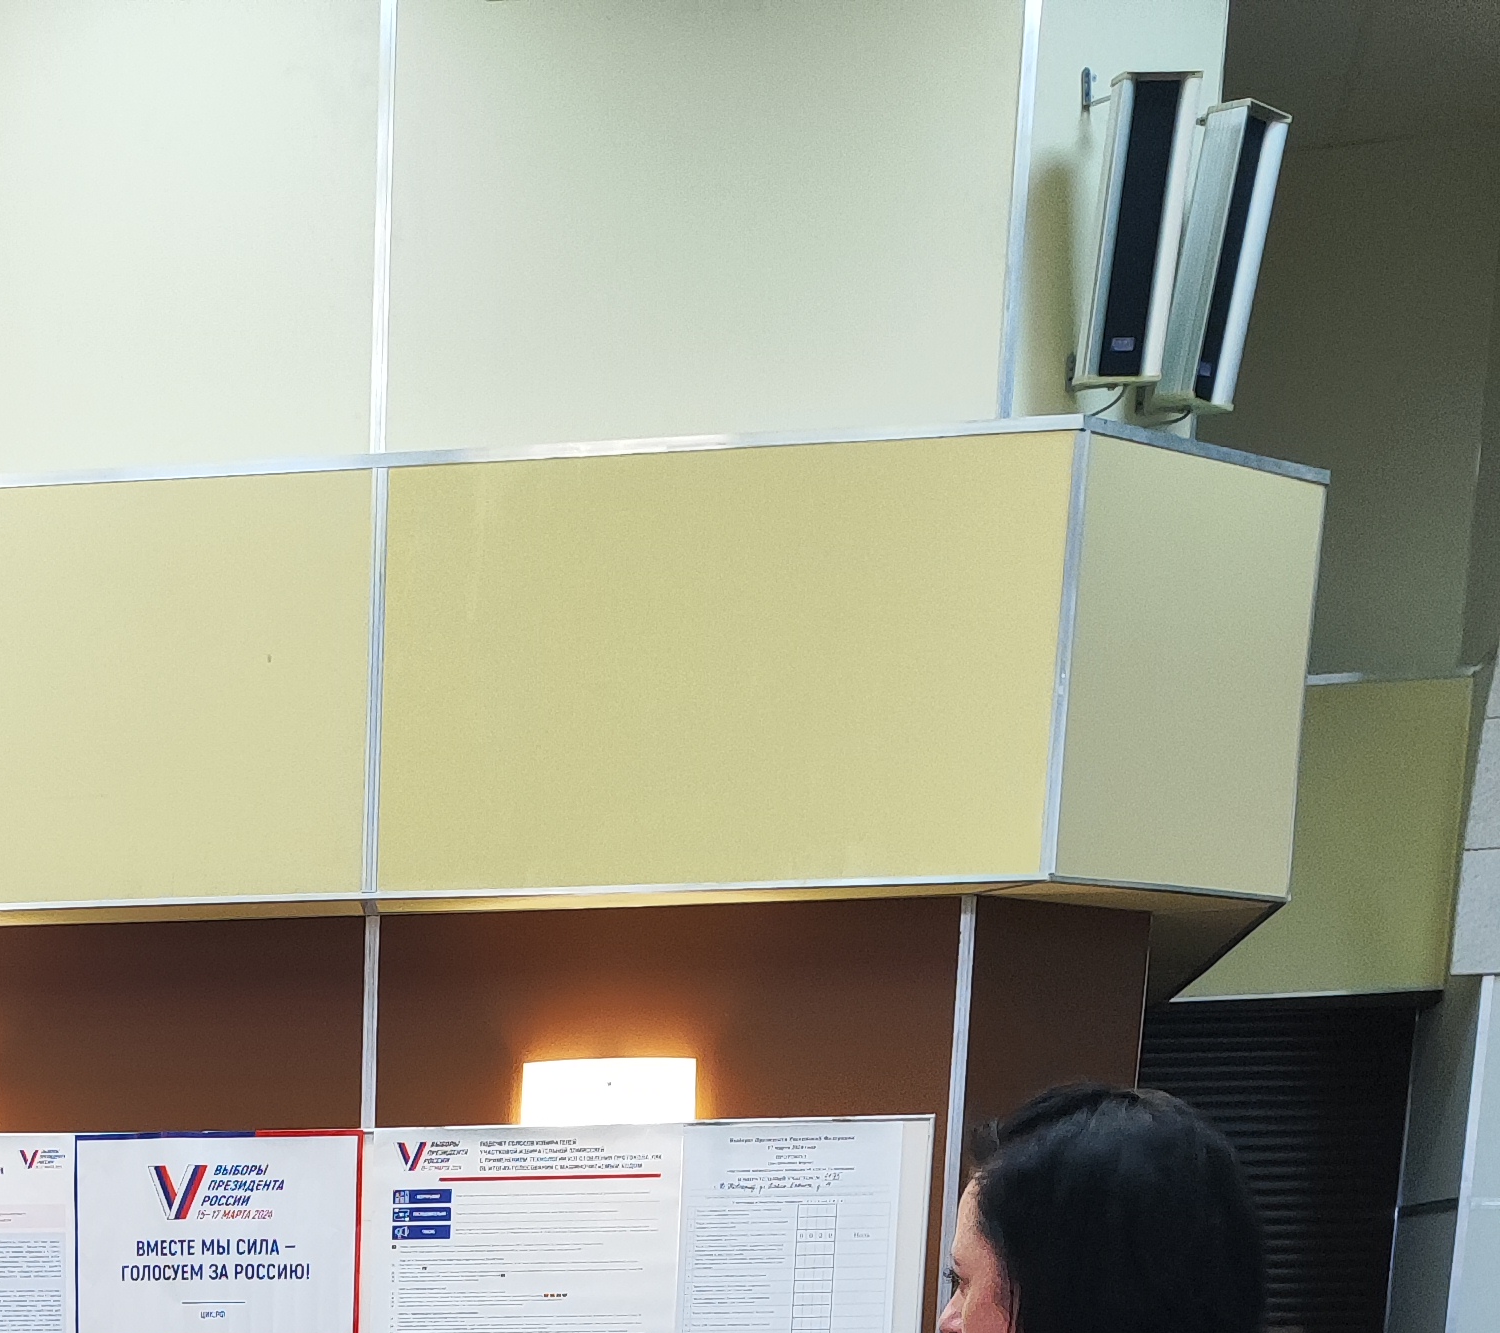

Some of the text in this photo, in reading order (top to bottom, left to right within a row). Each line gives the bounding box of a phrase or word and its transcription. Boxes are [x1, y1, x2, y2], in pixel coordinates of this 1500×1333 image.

[213, 1164, 269, 1175] ВЫБОРЫ
[208, 1179, 285, 1192] ПРЕЗИДЕНТА
[201, 1195, 251, 1206] РОССИИ
[221, 1209, 251, 1219] МАРТА
[136, 1239, 196, 1256] ВМЕСТЕ
[201, 1239, 230, 1256] МЫ
[236, 1238, 280, 1255] СИЛА
[121, 1262, 311, 1281] ГОЛОСУЕМ ЗА РОССИЮ!
